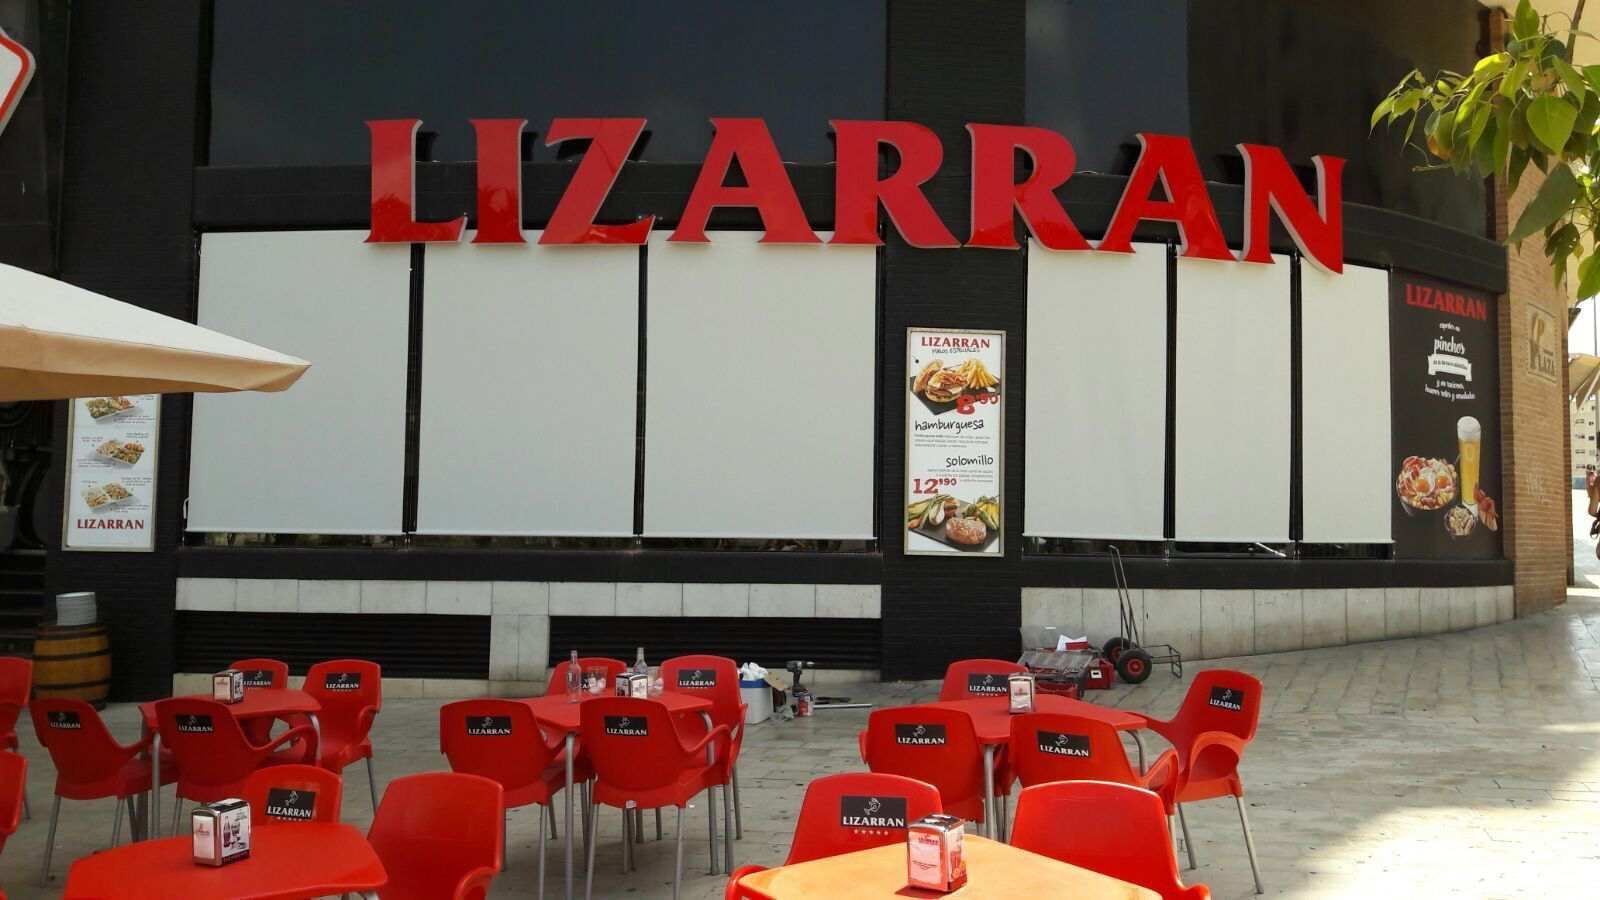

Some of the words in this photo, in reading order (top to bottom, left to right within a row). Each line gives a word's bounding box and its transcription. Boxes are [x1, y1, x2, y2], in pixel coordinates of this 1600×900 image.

[363, 117, 1346, 275] LIZARRAN
[1405, 283, 1487, 320] LIZARRAN
[921, 336, 990, 348] LIZARRAN
[1433, 336, 1466, 355] pinchos
[914, 417, 984, 434] hamburguesa
[946, 455, 994, 467] solomillo
[77, 519, 144, 529] LIZARRAN
[969, 684, 1008, 693] LIZARRAN
[1209, 697, 1241, 710] LIZARRAN
[606, 728, 647, 736] LIZARRAN
[897, 736, 945, 744] LIZARRAN
[1039, 744, 1089, 757] LIZARRAN
[267, 805, 312, 817] LIZARRAN
[842, 815, 904, 827] LIZARRAN
